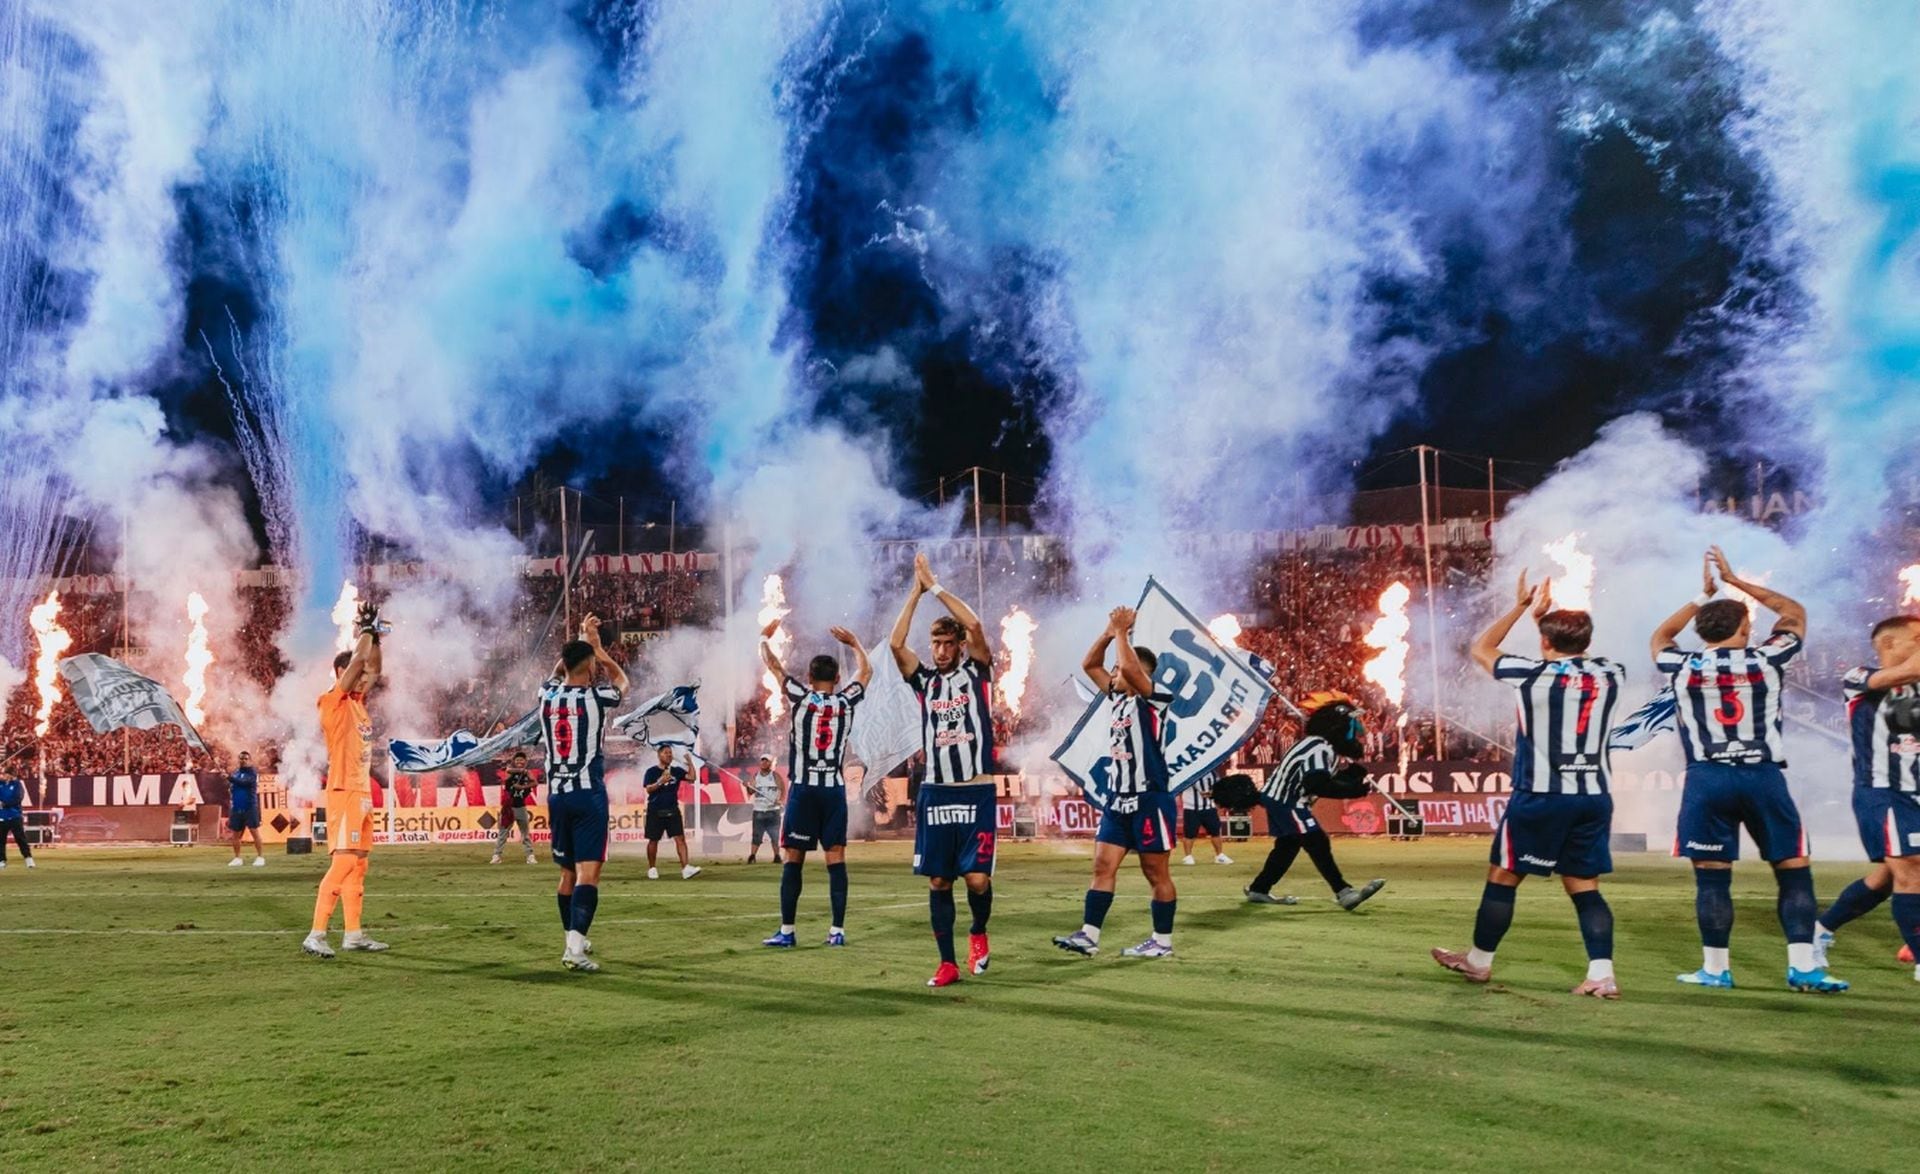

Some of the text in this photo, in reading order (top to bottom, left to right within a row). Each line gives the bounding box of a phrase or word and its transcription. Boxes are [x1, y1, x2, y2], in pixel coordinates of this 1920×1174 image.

[1576, 687, 1599, 735] 7
[1714, 690, 1745, 726] 3
[554, 719, 573, 758] 9
[815, 715, 833, 750] 5
[927, 804, 977, 825] ilumi
[1424, 803, 1458, 823] MAF
